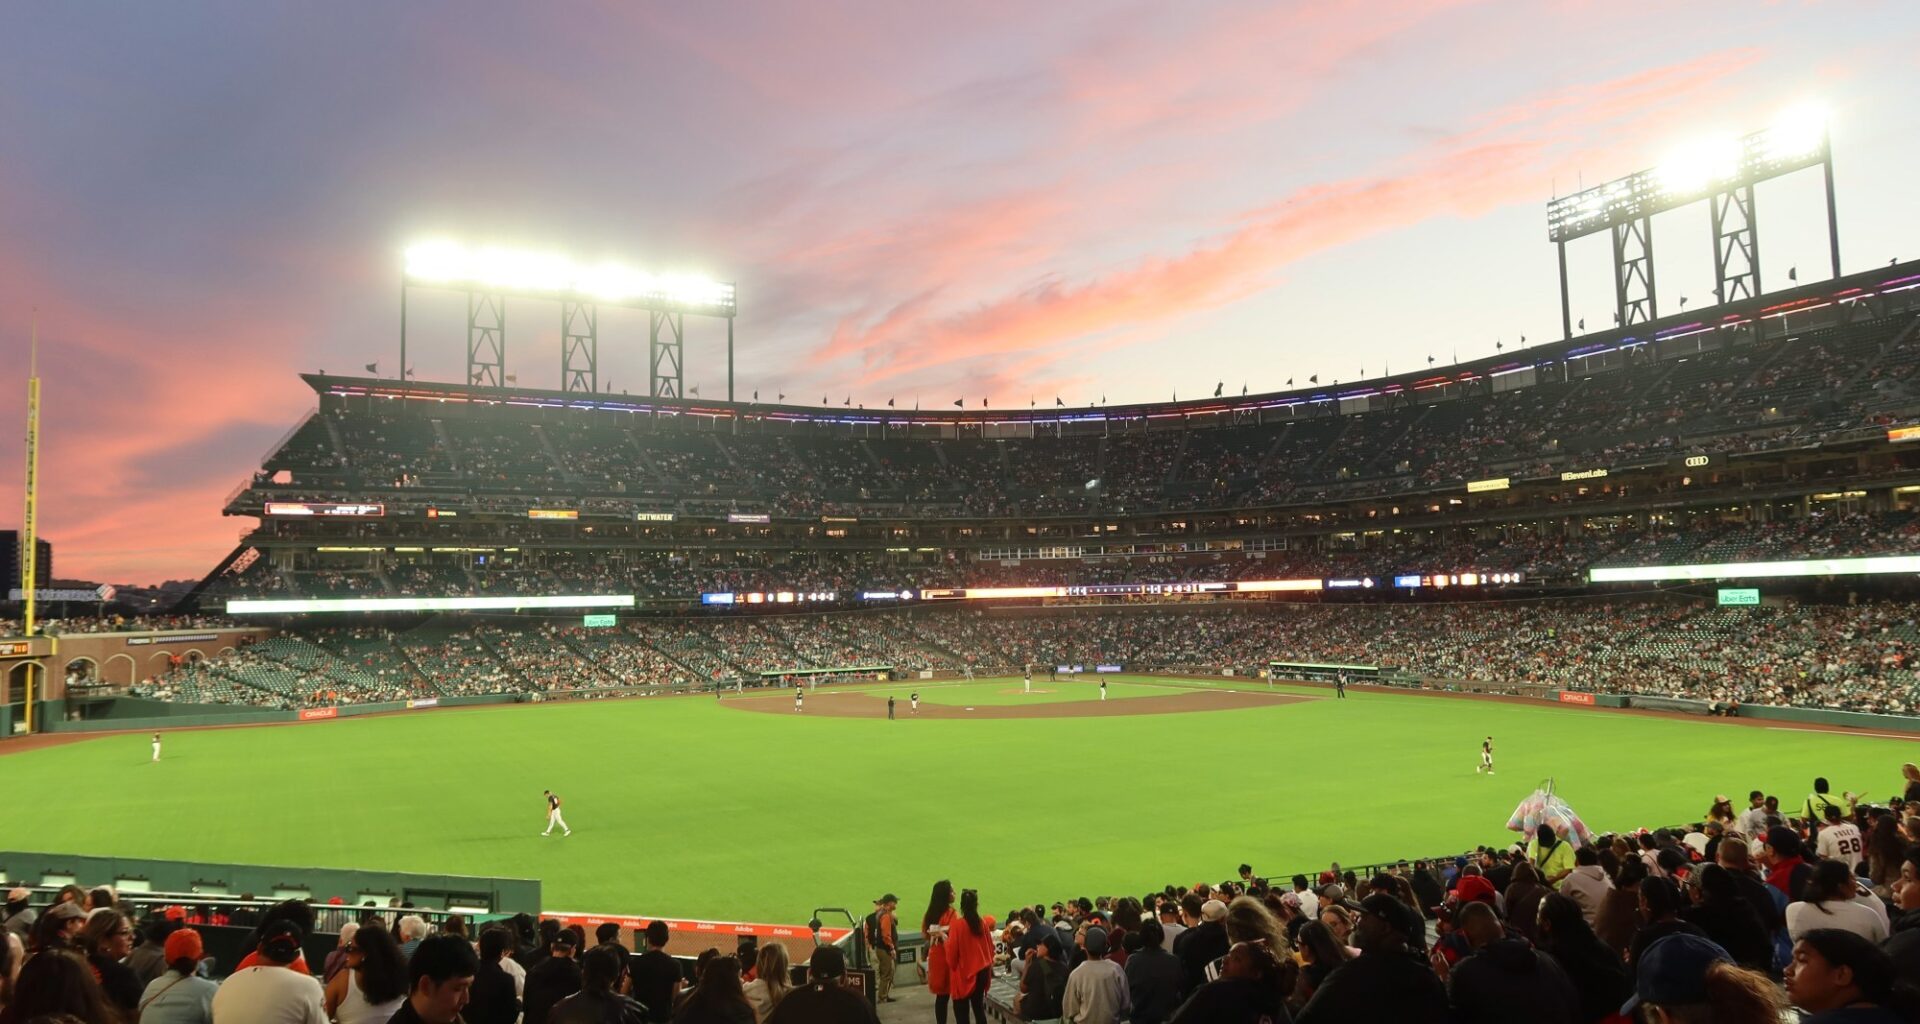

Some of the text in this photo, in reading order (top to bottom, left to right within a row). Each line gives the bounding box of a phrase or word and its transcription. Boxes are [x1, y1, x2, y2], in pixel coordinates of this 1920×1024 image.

[638, 513, 674, 521] CUTWATER
[1564, 694, 1589, 702] ORACLE
[304, 710, 332, 718] ORACLE
[1838, 838, 1861, 855] 28
[623, 919, 640, 927] Adobe
[773, 928, 792, 936] Adobe
